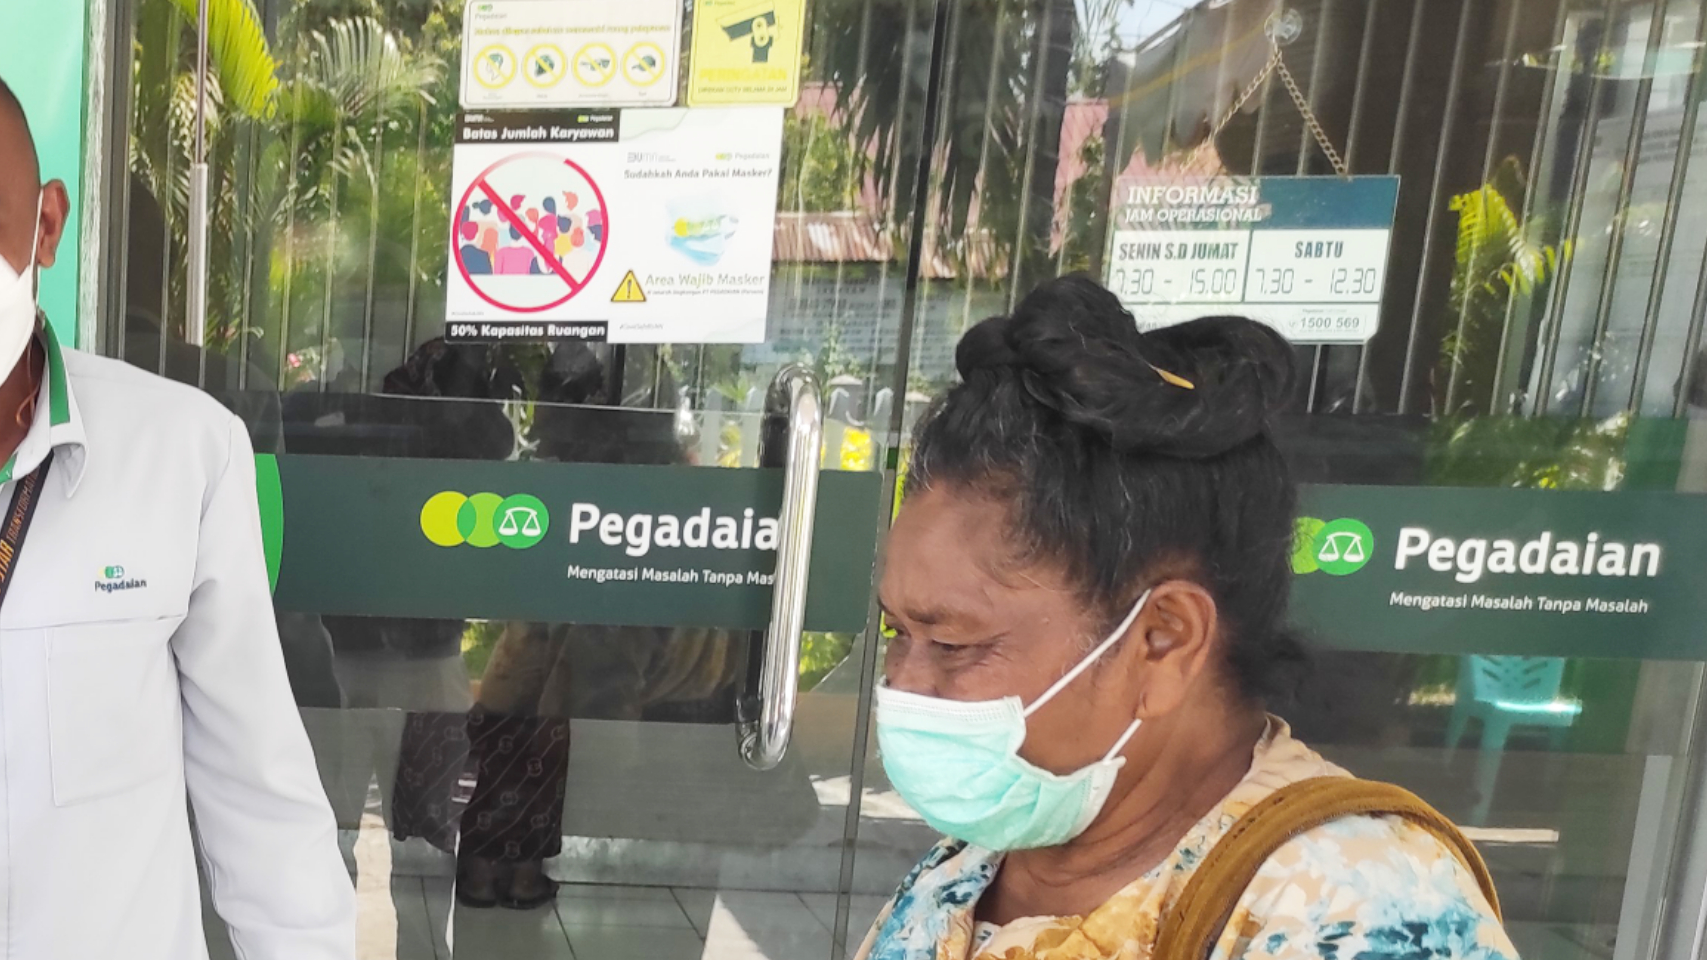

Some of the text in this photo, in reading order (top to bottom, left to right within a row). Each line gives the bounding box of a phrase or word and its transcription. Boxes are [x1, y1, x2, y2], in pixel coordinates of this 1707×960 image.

[463, 125, 614, 142] Batas Jumlah Karyawan
[624, 167, 773, 180] Sudahkah Anda Pakai Masker?
[1126, 185, 1260, 205] INFORMASI
[1125, 207, 1262, 224] JAM OPERASIONAL
[1119, 242, 1239, 260] SENIN S.D JUMAT
[1295, 241, 1344, 258] SABTU
[645, 273, 765, 288] Area Wajib Masker
[1189, 268, 1237, 294] 15.00
[1255, 268, 1294, 295] 7.30
[1329, 268, 1376, 295] 12.30
[1300, 316, 1360, 329] 1500 569
[451, 324, 606, 339] 50% Kapasitas Ruangan
[569, 502, 779, 557] Pegadaia
[1395, 527, 1661, 583] Pegadaian
[567, 564, 638, 583] Mengatasi
[641, 567, 698, 583] Masalah
[702, 569, 743, 588] Tanpa
[95, 578, 147, 593] Pegadaian
[1389, 591, 1648, 614] Mengatasi Masalah Tanpa Masalah
